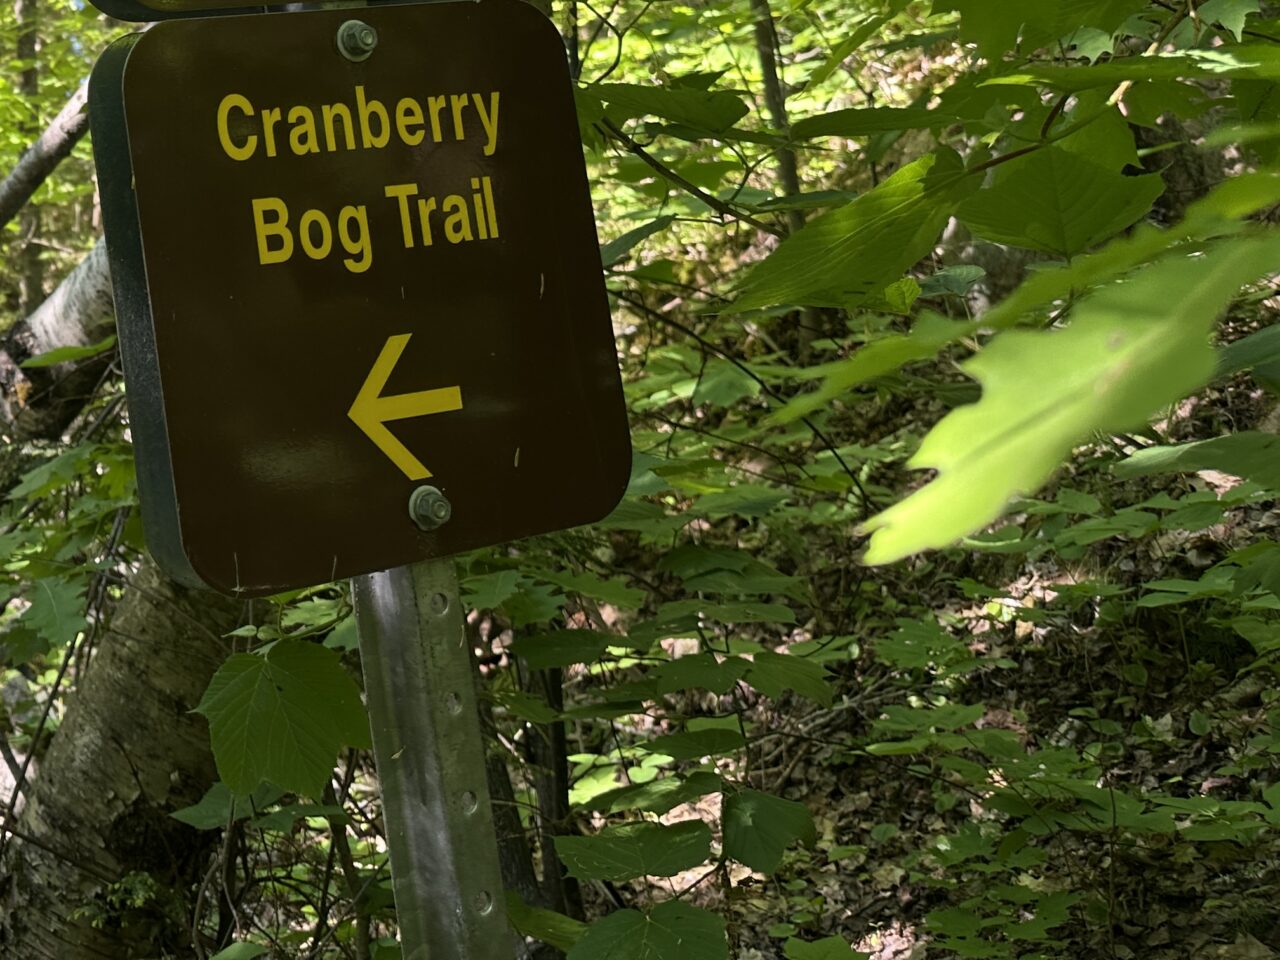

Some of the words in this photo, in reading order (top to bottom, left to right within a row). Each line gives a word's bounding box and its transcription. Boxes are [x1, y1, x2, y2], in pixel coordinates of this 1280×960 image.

[217, 85, 500, 161] Cranberry
[252, 197, 373, 273] Bog
[385, 176, 499, 248] Trail
